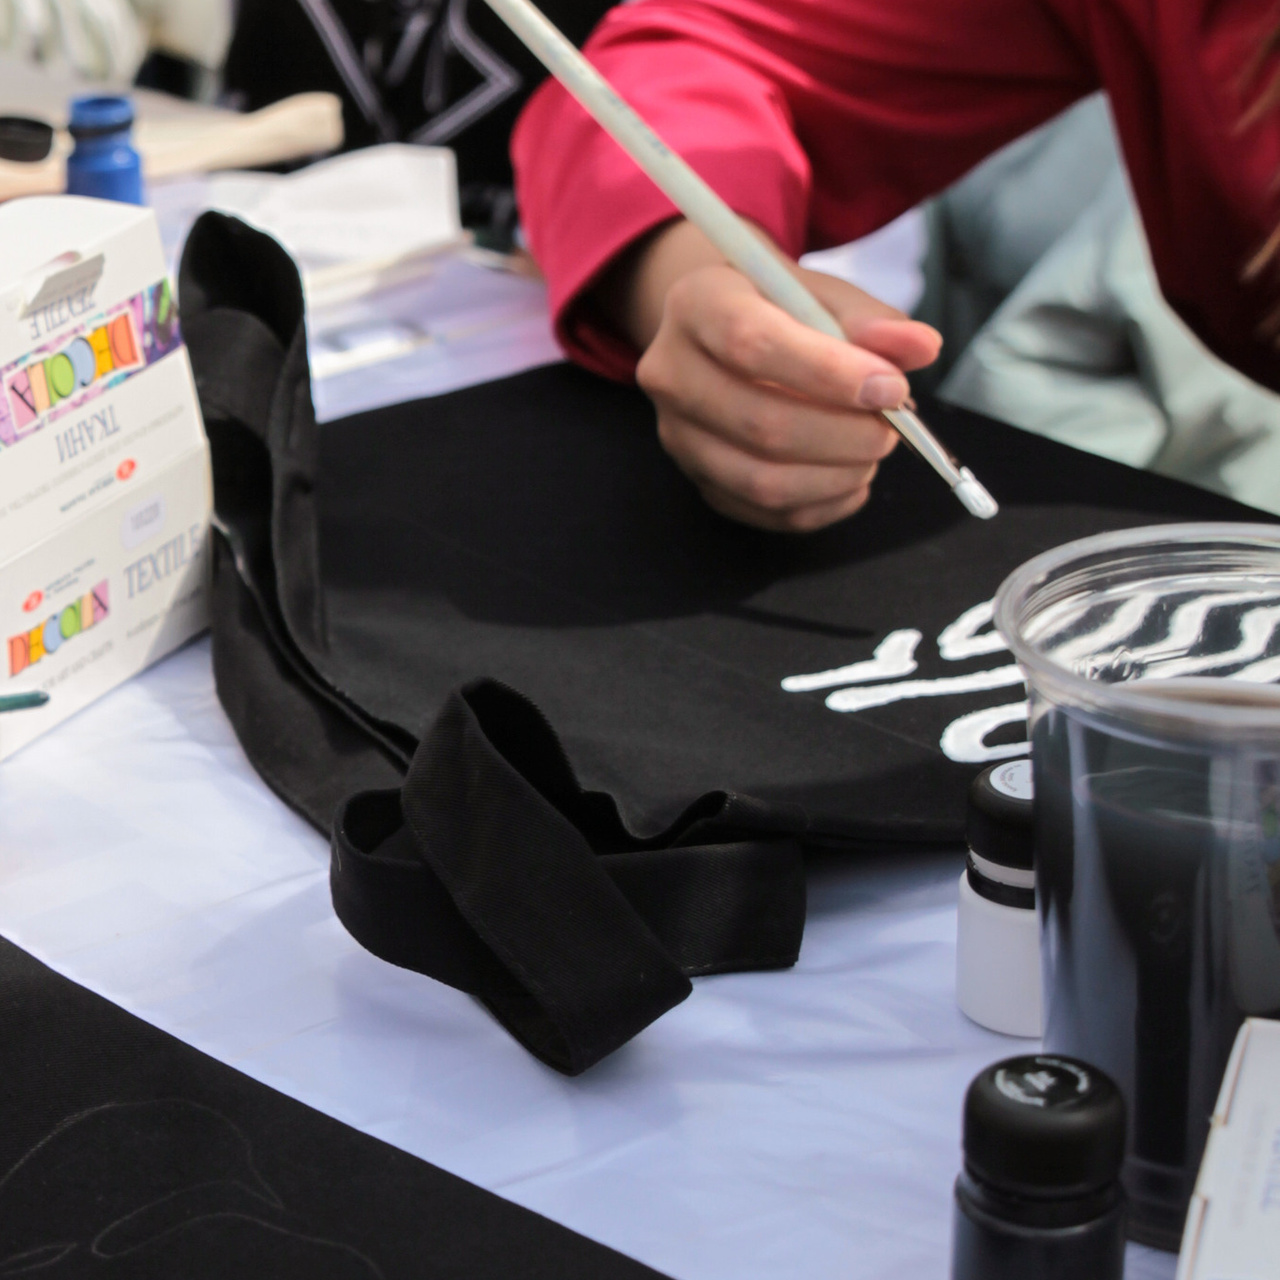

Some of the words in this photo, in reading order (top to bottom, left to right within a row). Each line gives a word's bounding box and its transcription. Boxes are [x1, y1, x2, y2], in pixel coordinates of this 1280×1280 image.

[7, 312, 140, 424] DECOLA
[55, 404, 121, 463] ТКАНИ
[124, 524, 199, 600] TEXTILE
[8, 582, 110, 677] DECOLA
